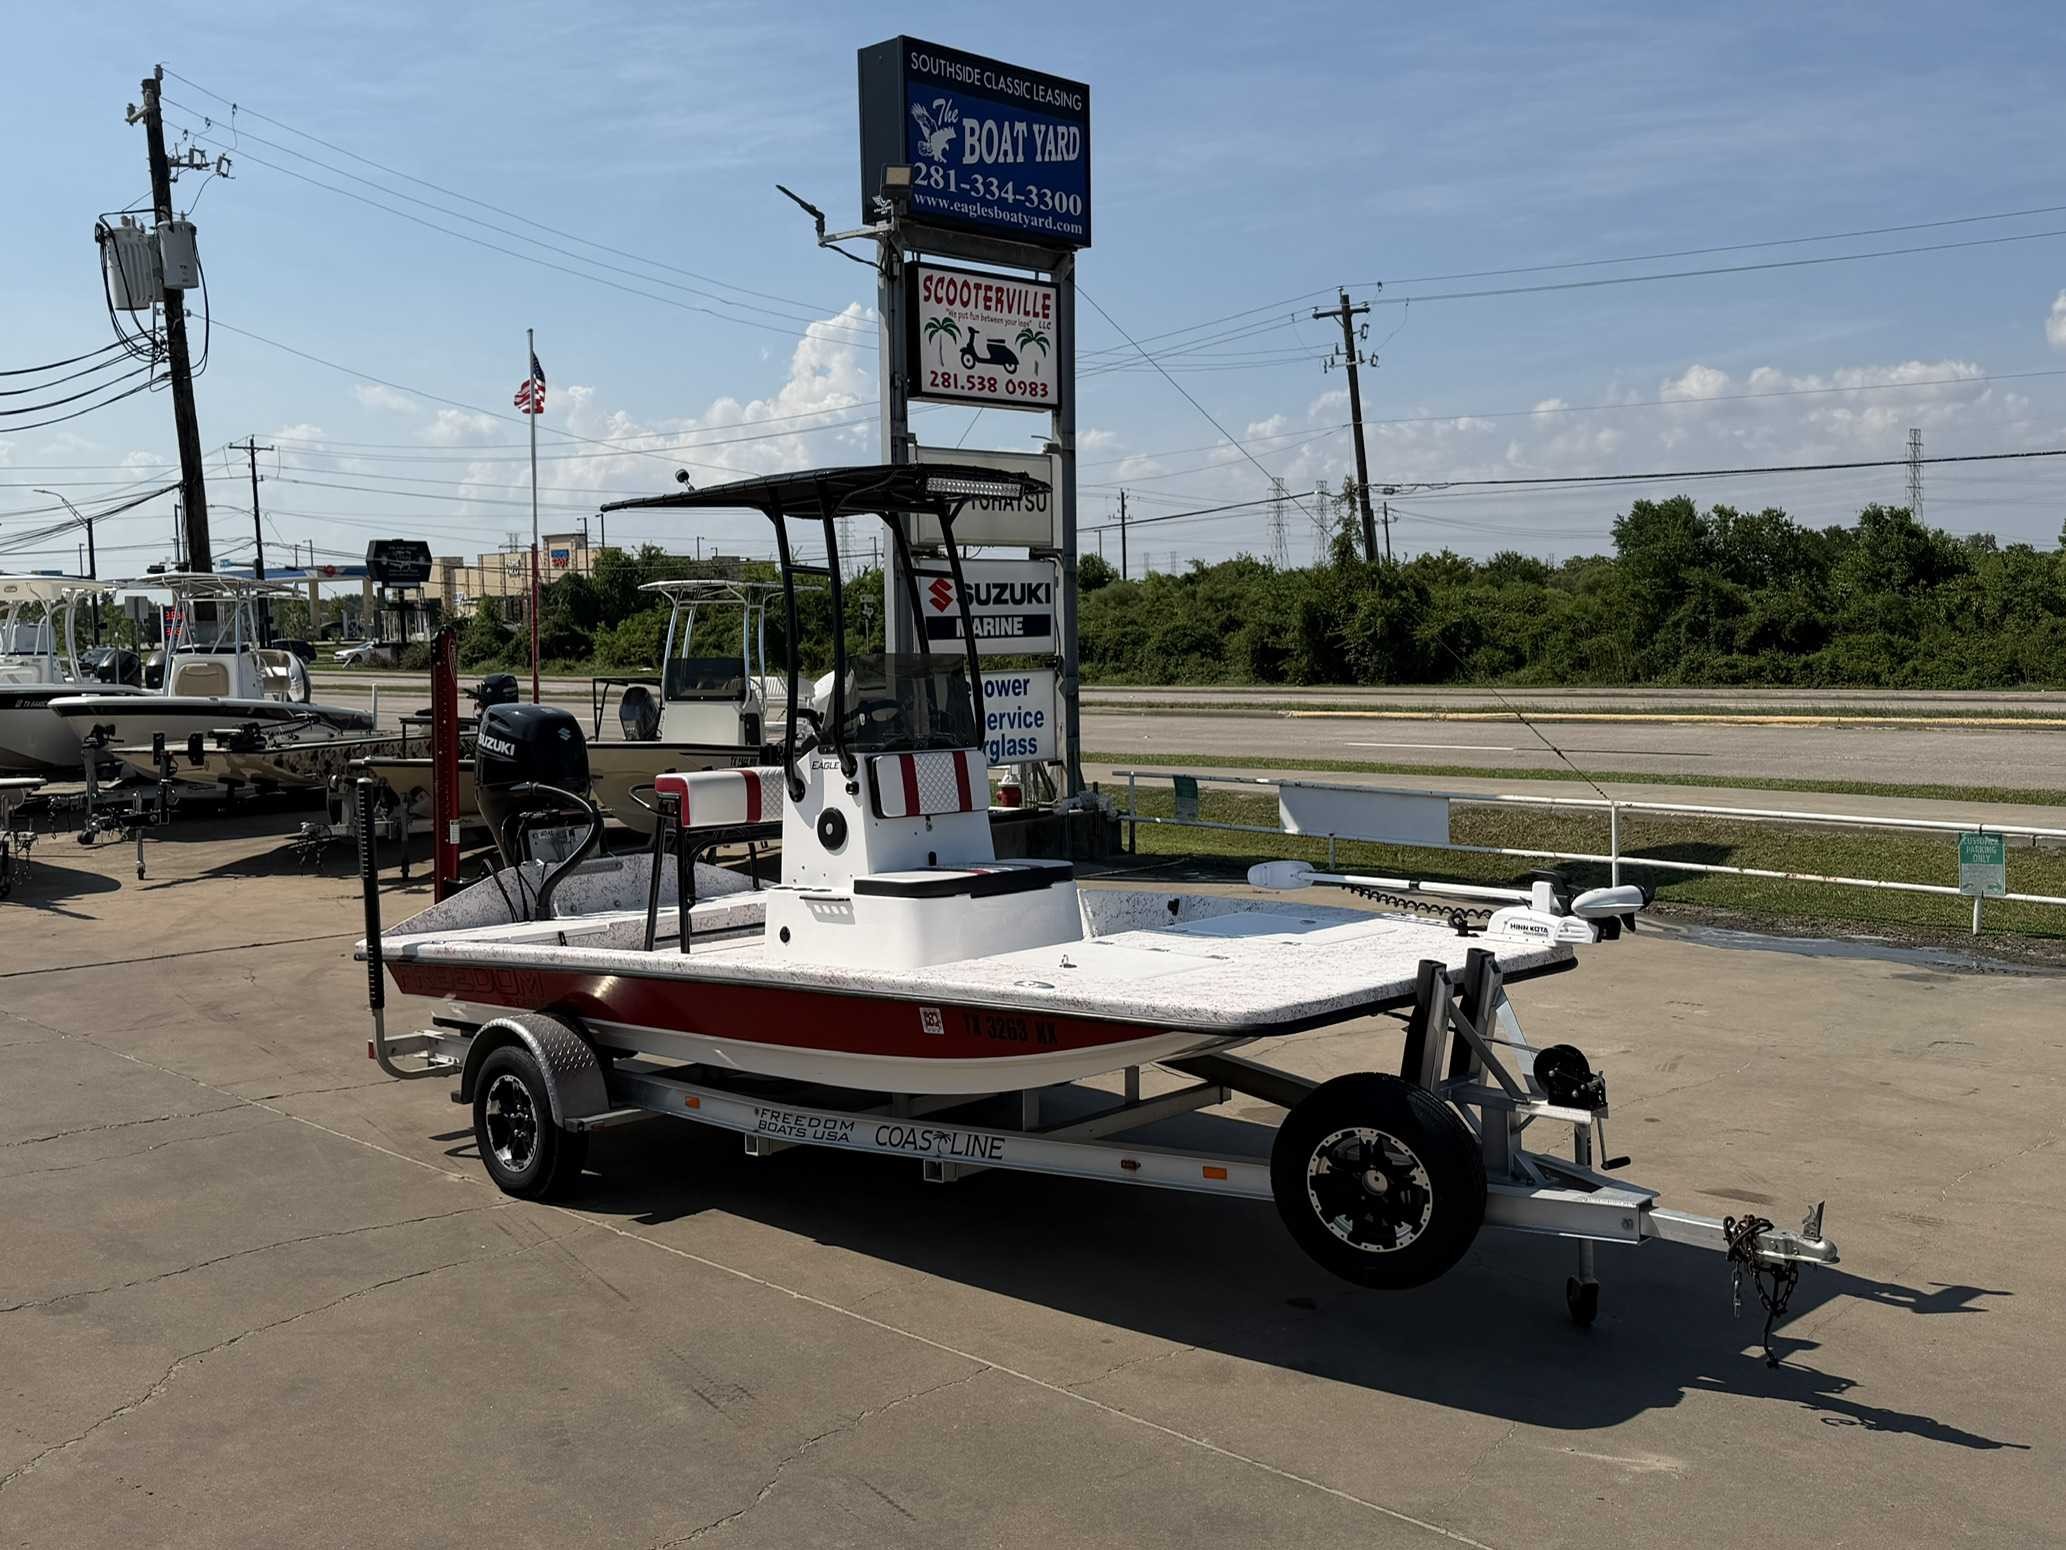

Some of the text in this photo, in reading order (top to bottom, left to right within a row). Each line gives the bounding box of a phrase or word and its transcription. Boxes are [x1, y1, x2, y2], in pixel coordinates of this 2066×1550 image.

[911, 52, 1082, 111] SOUTHSIDE CLASSIC LEASING
[933, 98, 959, 126] The
[962, 118, 1080, 165] BOAT YARD
[914, 162, 1082, 216] 281-334-3300
[914, 192, 1082, 235] www.eaglesboatyard.com
[923, 274, 1051, 319] SCOOTERVILLE
[1039, 320, 1051, 330] LLC
[930, 370, 1049, 398] 281.538 0983
[964, 582, 1051, 606] SUZUKI
[984, 678, 1030, 698] ower
[987, 706, 1044, 731] ervice
[478, 733, 516, 756] SUZUKI
[811, 760, 840, 770] EAGLE
[758, 1120, 850, 1143] BOATS USA
[760, 1109, 855, 1132] FREEDOM
